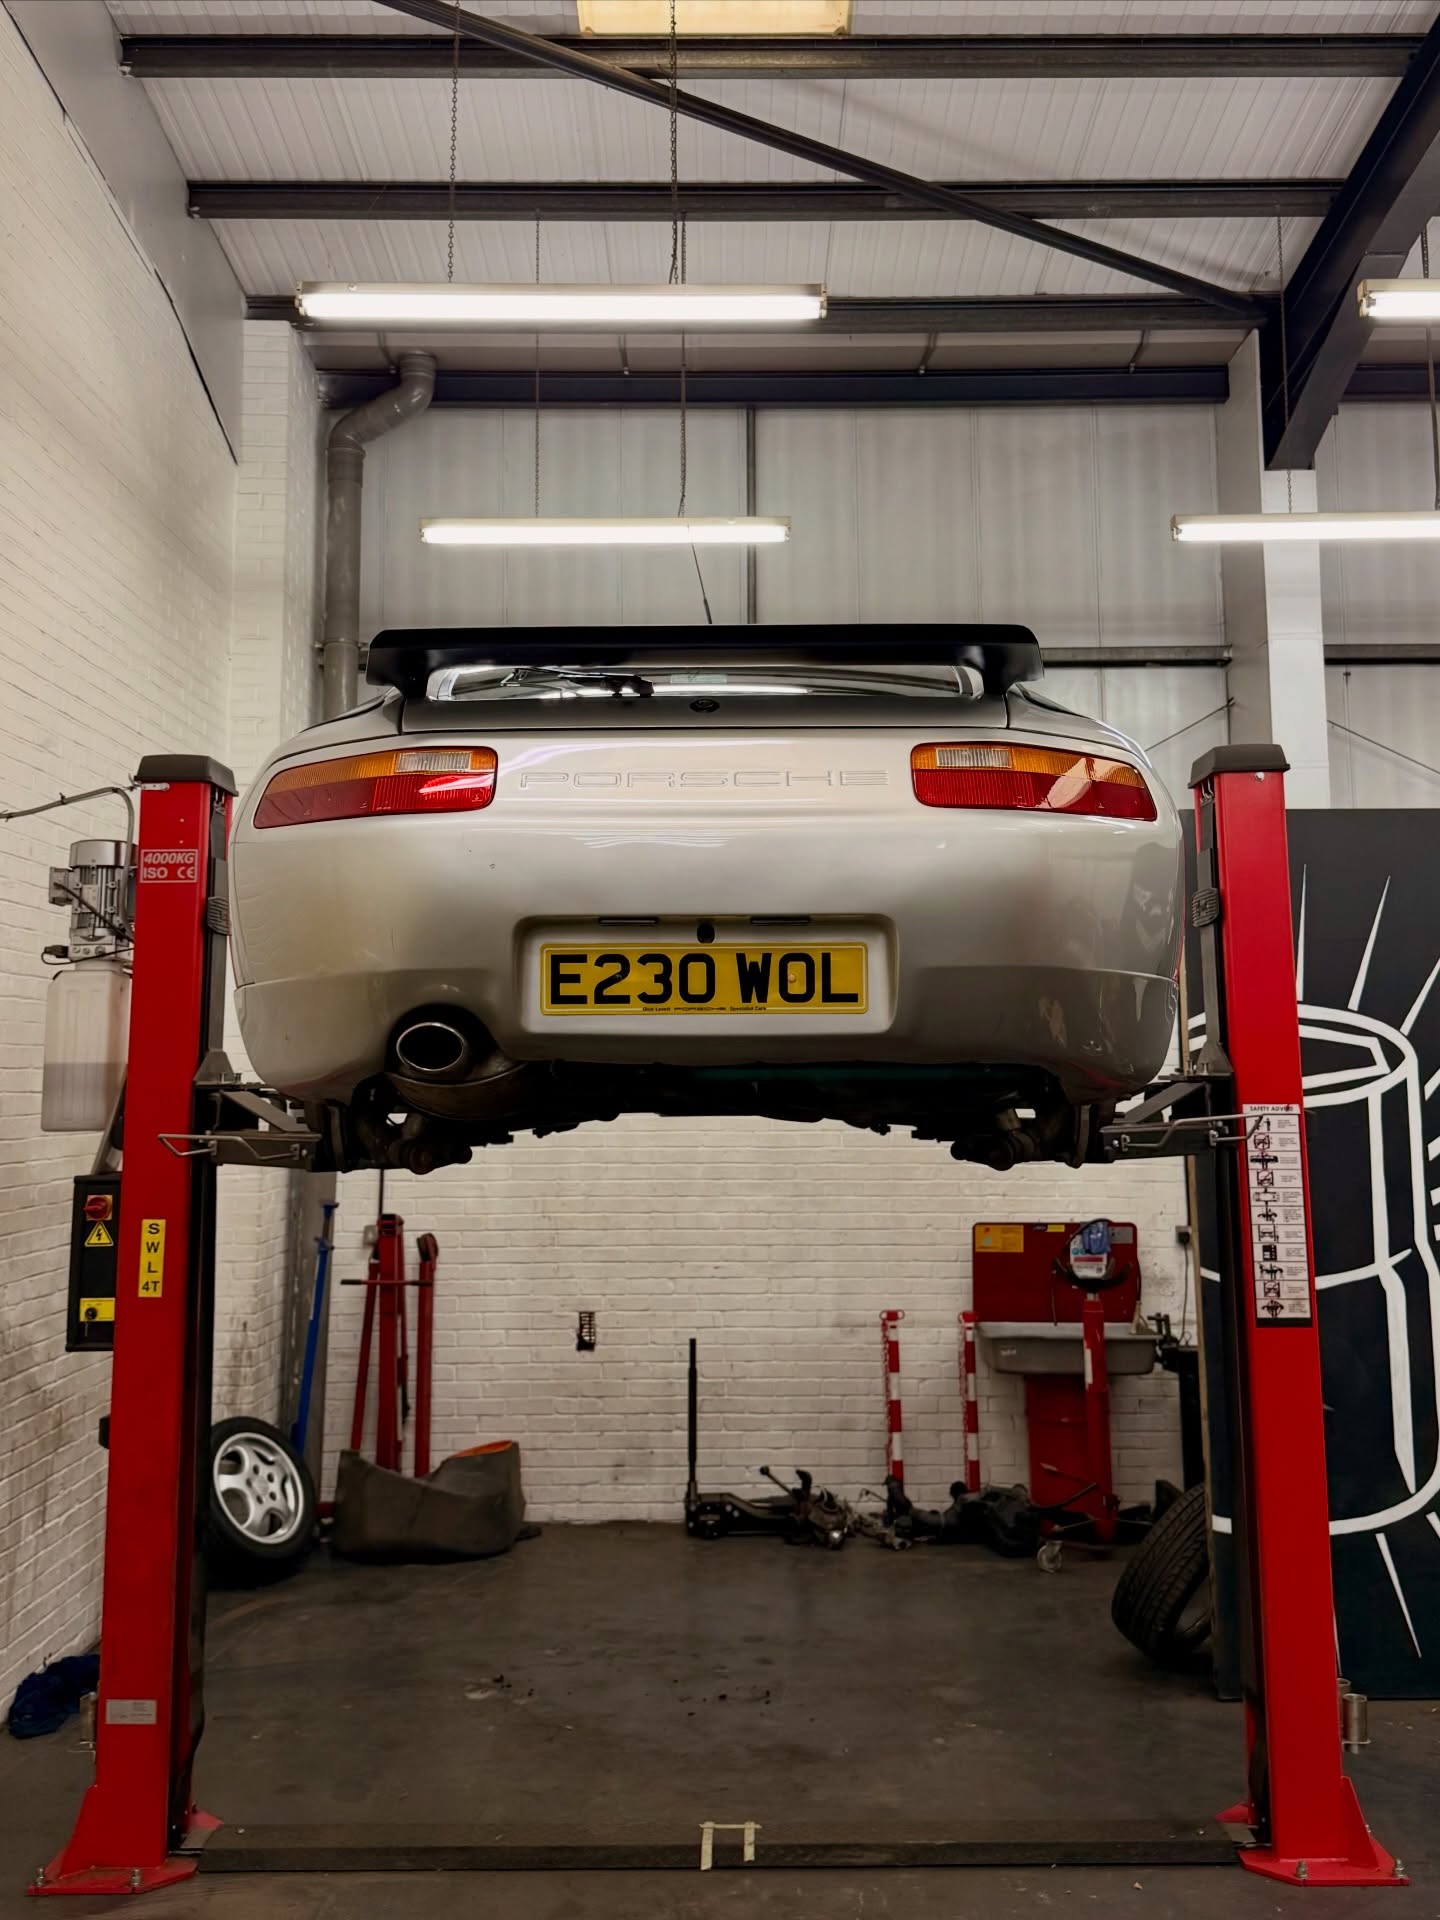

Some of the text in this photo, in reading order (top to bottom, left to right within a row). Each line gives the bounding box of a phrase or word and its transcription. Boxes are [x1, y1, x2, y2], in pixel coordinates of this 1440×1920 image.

[519, 770, 889, 789] PORSCHE
[144, 852, 195, 864] 4000KG
[143, 866, 195, 879] ISO CE
[550, 952, 858, 1005] E230 WOL
[141, 1281, 160, 1292] 4T
